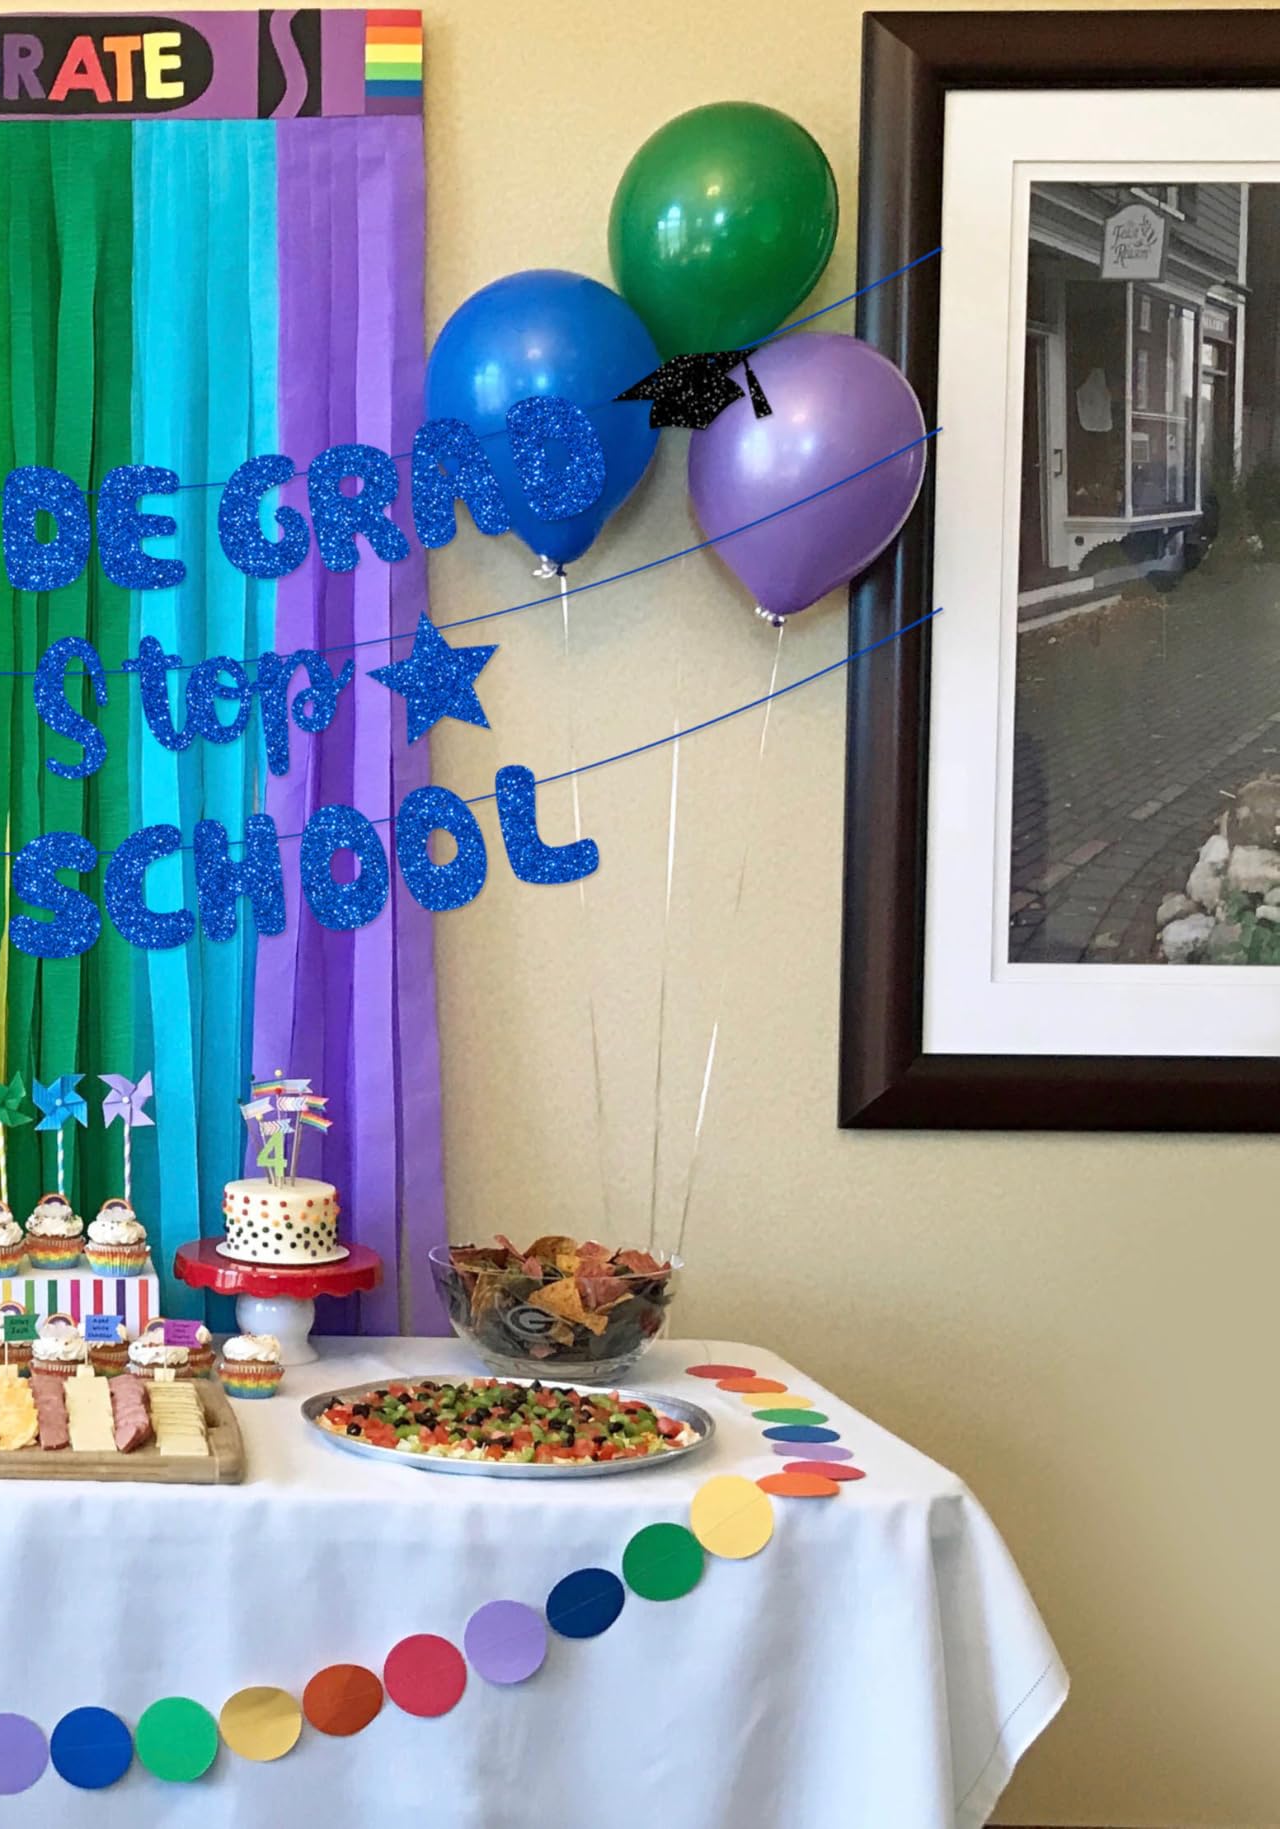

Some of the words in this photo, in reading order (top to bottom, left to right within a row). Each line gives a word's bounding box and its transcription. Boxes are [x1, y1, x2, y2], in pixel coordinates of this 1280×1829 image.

[219, 395, 606, 579] GRAD
[9, 764, 599, 959] SCHOOL
[257, 1131, 288, 1178] 4
